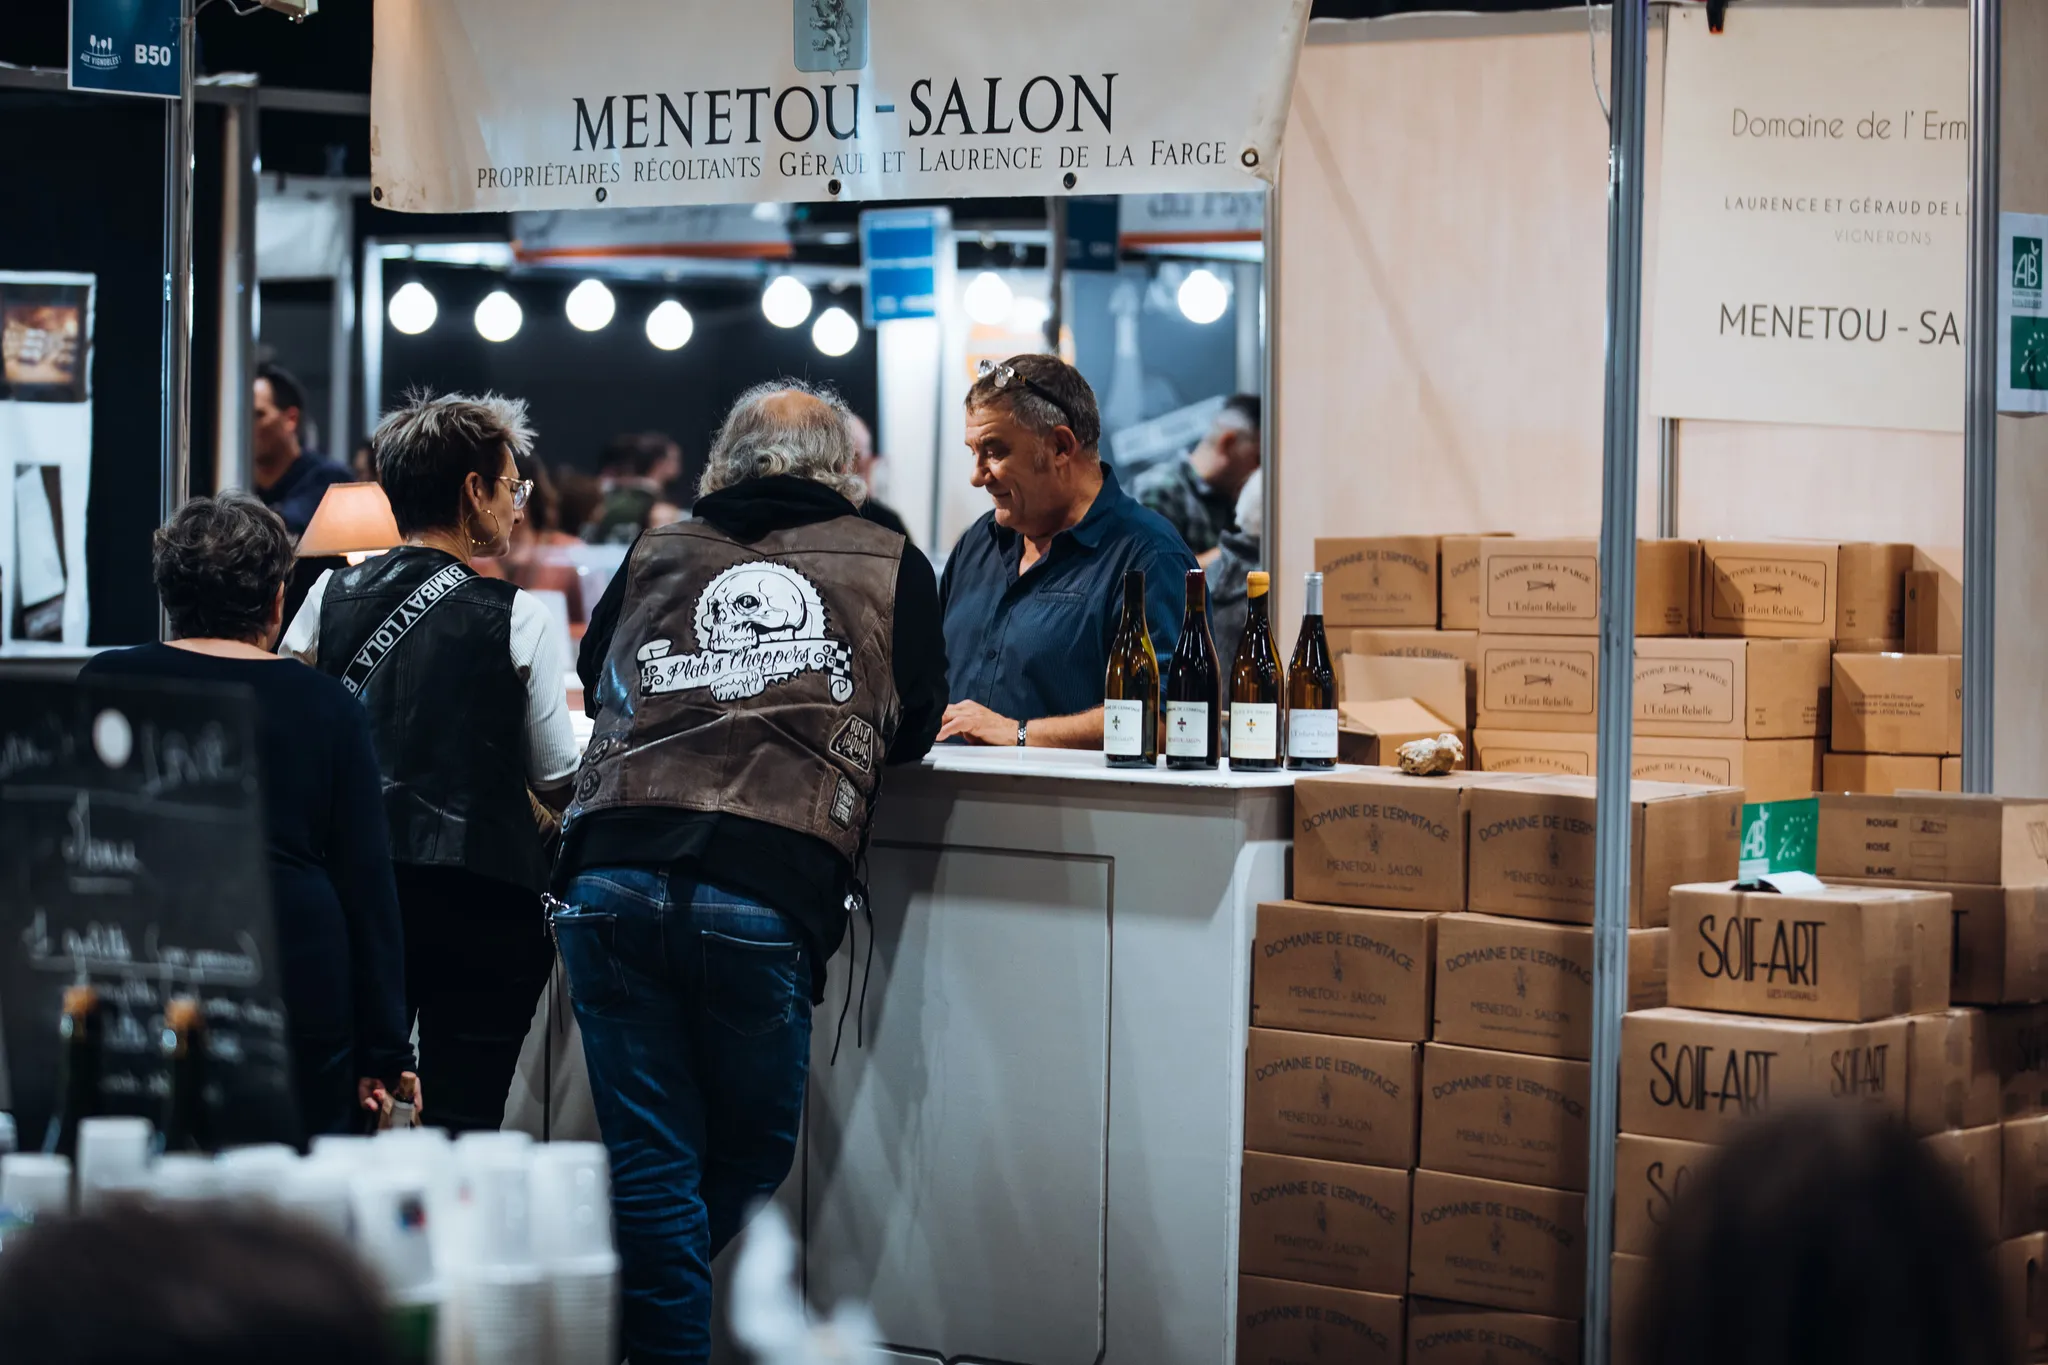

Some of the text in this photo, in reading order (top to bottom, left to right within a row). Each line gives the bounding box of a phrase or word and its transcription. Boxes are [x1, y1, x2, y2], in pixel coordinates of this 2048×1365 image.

[80, 52, 91, 63] AUX
[135, 44, 171, 66] B50
[1732, 108, 1844, 140] Domaine
[1856, 110, 1891, 140] de
[477, 162, 621, 189] PROPRIÉTAIRES
[633, 156, 761, 183] RÉCOLTANTS
[882, 150, 905, 174] ET
[1058, 146, 1089, 168] DE
[1105, 144, 1134, 168] LA
[1725, 196, 1818, 213] LAURENCE
[1824, 198, 1843, 213] ET
[1849, 195, 1921, 215] GÉRAUD
[1927, 200, 1948, 215] DE
[1834, 229, 1932, 245] VIGNERONS
[2013, 253, 2038, 287] AB
[1918, 310, 1962, 345] SA
[1451, 555, 1480, 578] DOMA
[1532, 562, 1543, 571] DE
[1759, 565, 1772, 573] DE
[1545, 600, 1577, 612] Rebelle
[1772, 603, 1804, 617] Rebelle
[355, 618, 404, 668] LOLA
[729, 645, 812, 675] Choppers
[1529, 656, 1541, 665] DE
[1633, 665, 1666, 682] NTOINE
[1668, 665, 1681, 673] DE
[1682, 704, 1713, 716] Rebelle
[1524, 755, 1536, 763] DE
[1664, 763, 1675, 771] DE
[1301, 804, 1450, 843] DOMAINE DE L'ERMITAGE
[1478, 814, 1539, 842] DOMAINE
[1543, 814, 1561, 830] DE
[1866, 817, 1899, 829] ROUGE
[1741, 820, 1766, 858] AB
[1326, 859, 1423, 877] MENETOU SALON
[1865, 865, 1896, 877] BLANC
[1264, 930, 1415, 973] DOMAINE DE L'ERMITAGE
[1697, 914, 1826, 987] SOIF-ART
[1445, 945, 1592, 986] DOMAINE DE L'ERMITAG
[1288, 985, 1387, 1006] MENETOU SALON
[1255, 1055, 1400, 1099] DOMAINE DE L'ERMITAGE
[1431, 1073, 1493, 1100] DOMAINE
[1496, 1074, 1513, 1090] DE
[1249, 1180, 1308, 1206] DOMAINE
[1310, 1179, 1328, 1196] DE
[1421, 1201, 1483, 1226] DOMAINE
[1485, 1201, 1503, 1218] DE
